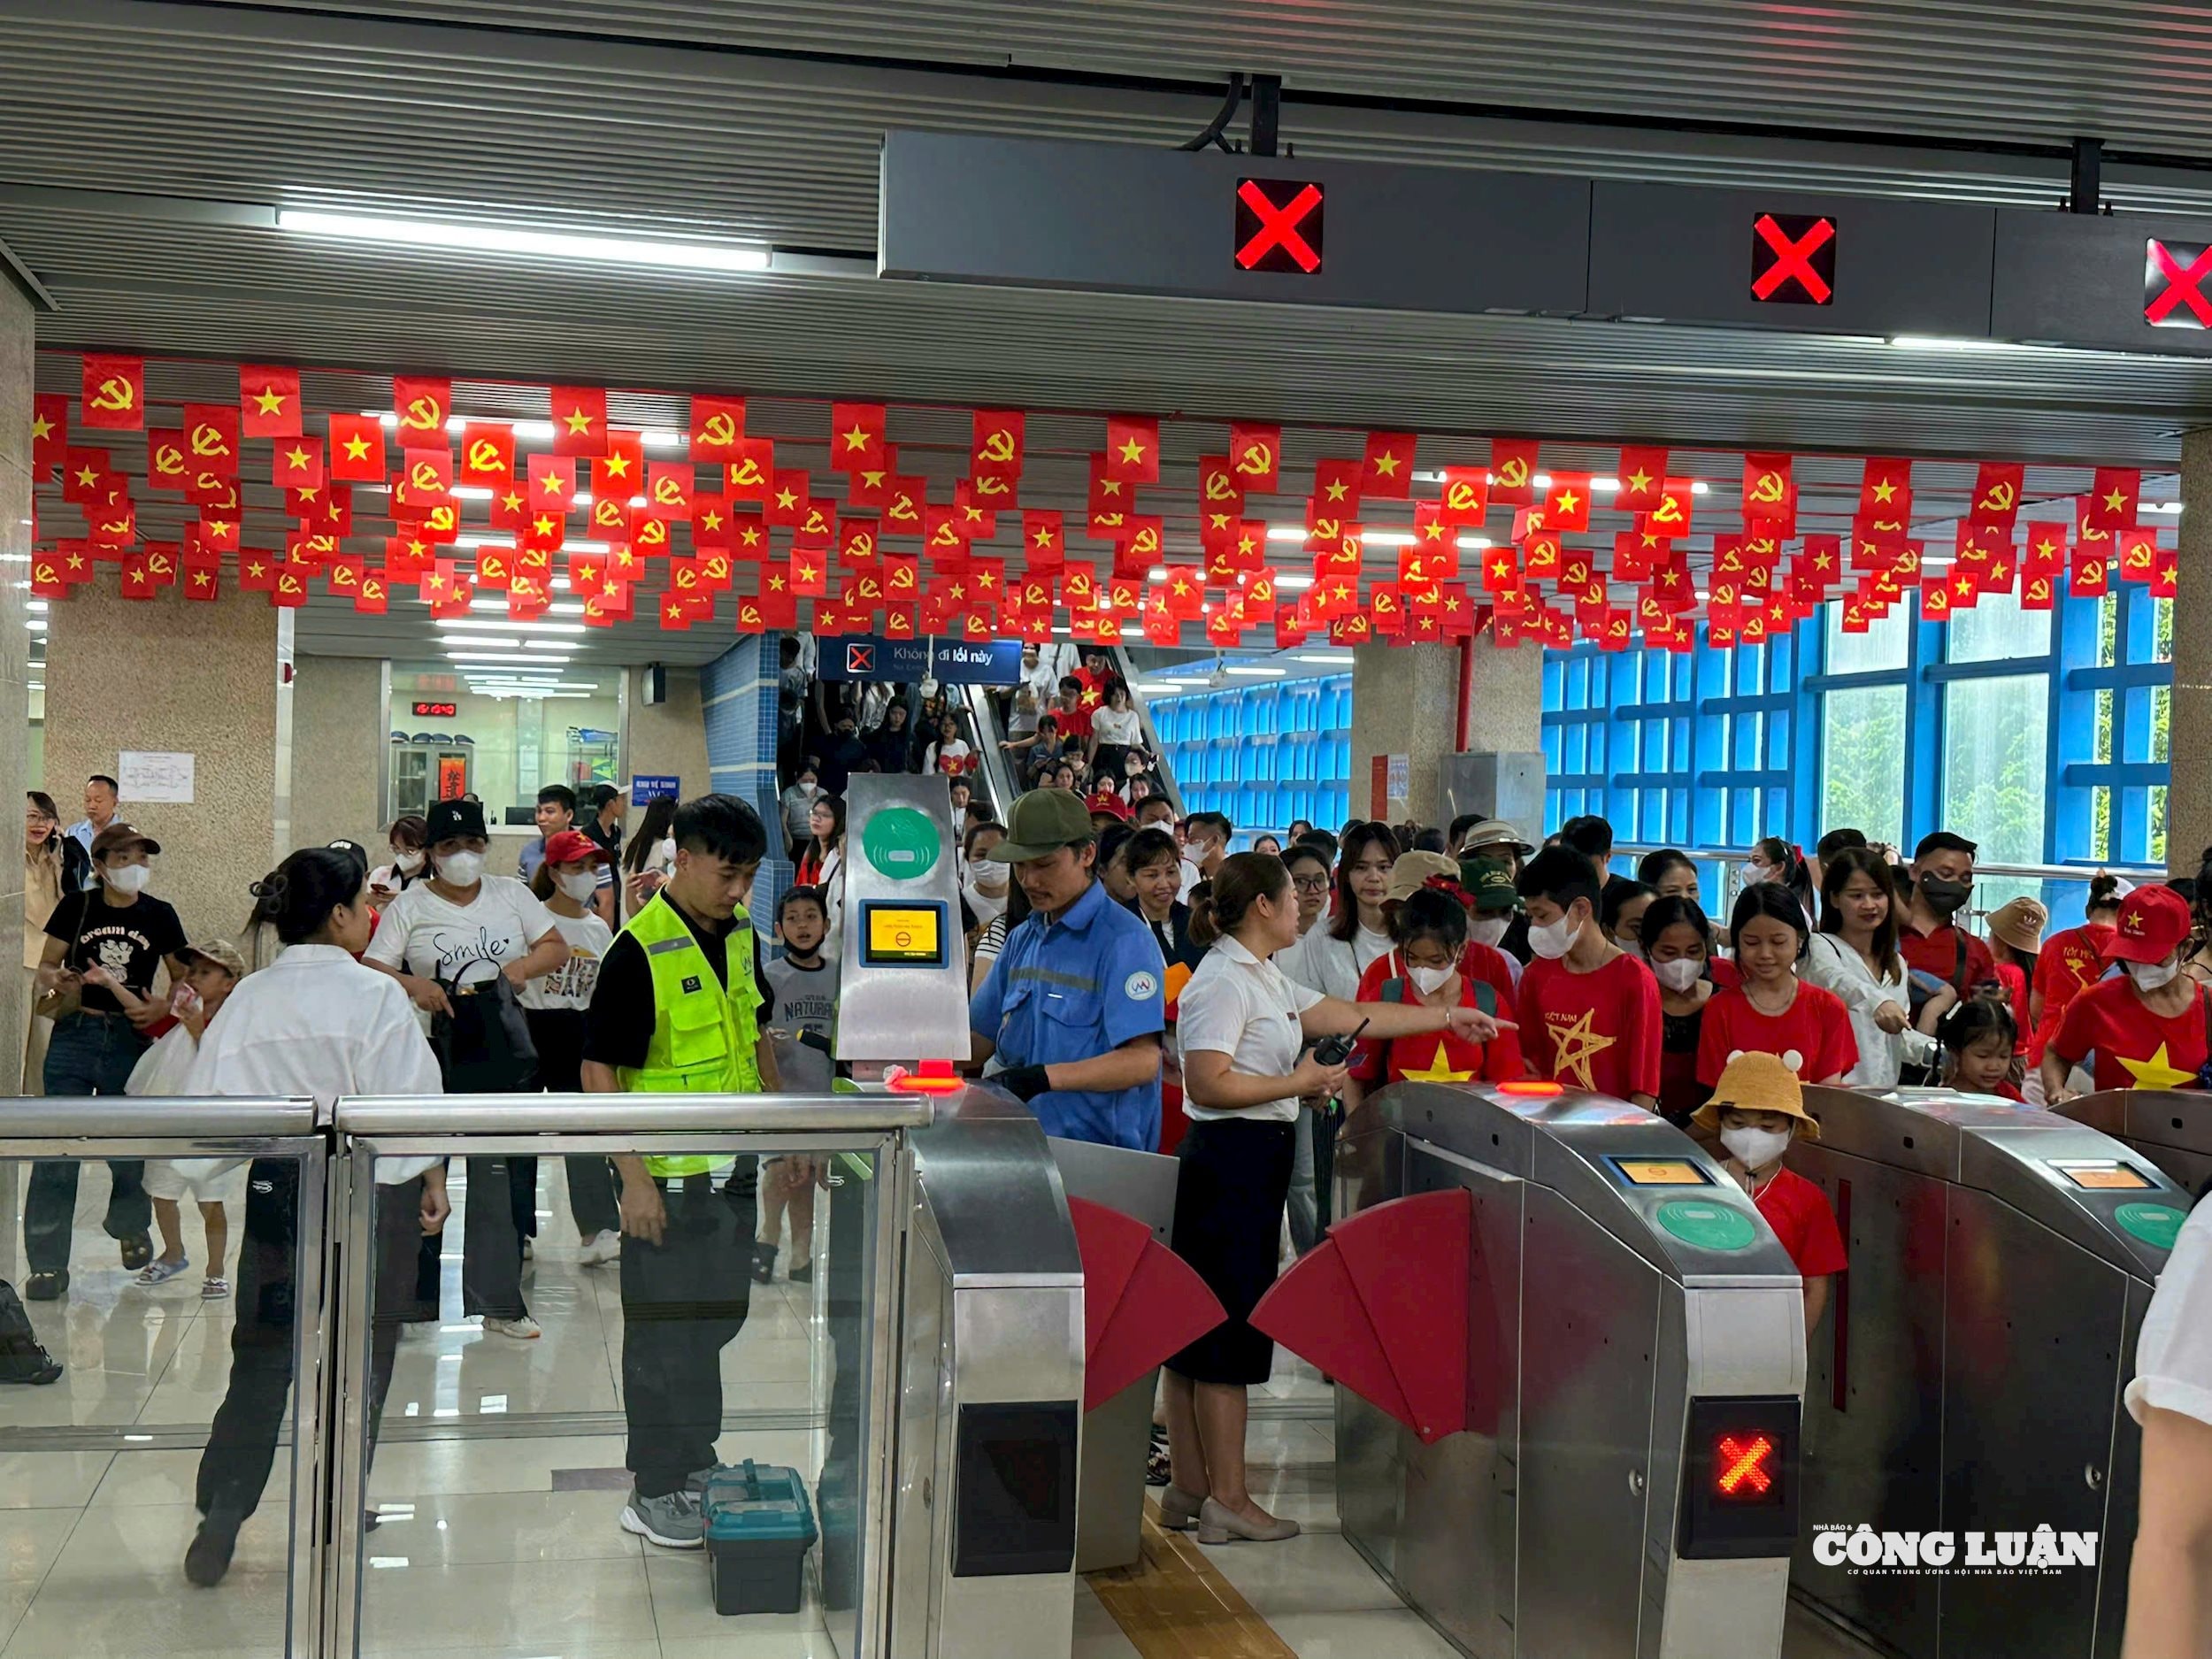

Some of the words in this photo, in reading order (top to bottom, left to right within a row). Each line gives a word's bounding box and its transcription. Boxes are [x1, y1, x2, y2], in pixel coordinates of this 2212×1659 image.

[894, 647, 934, 660] Khôn
[970, 649, 993, 666] này
[433, 926, 506, 966] Smile
[784, 1001, 833, 1022] NATURA
